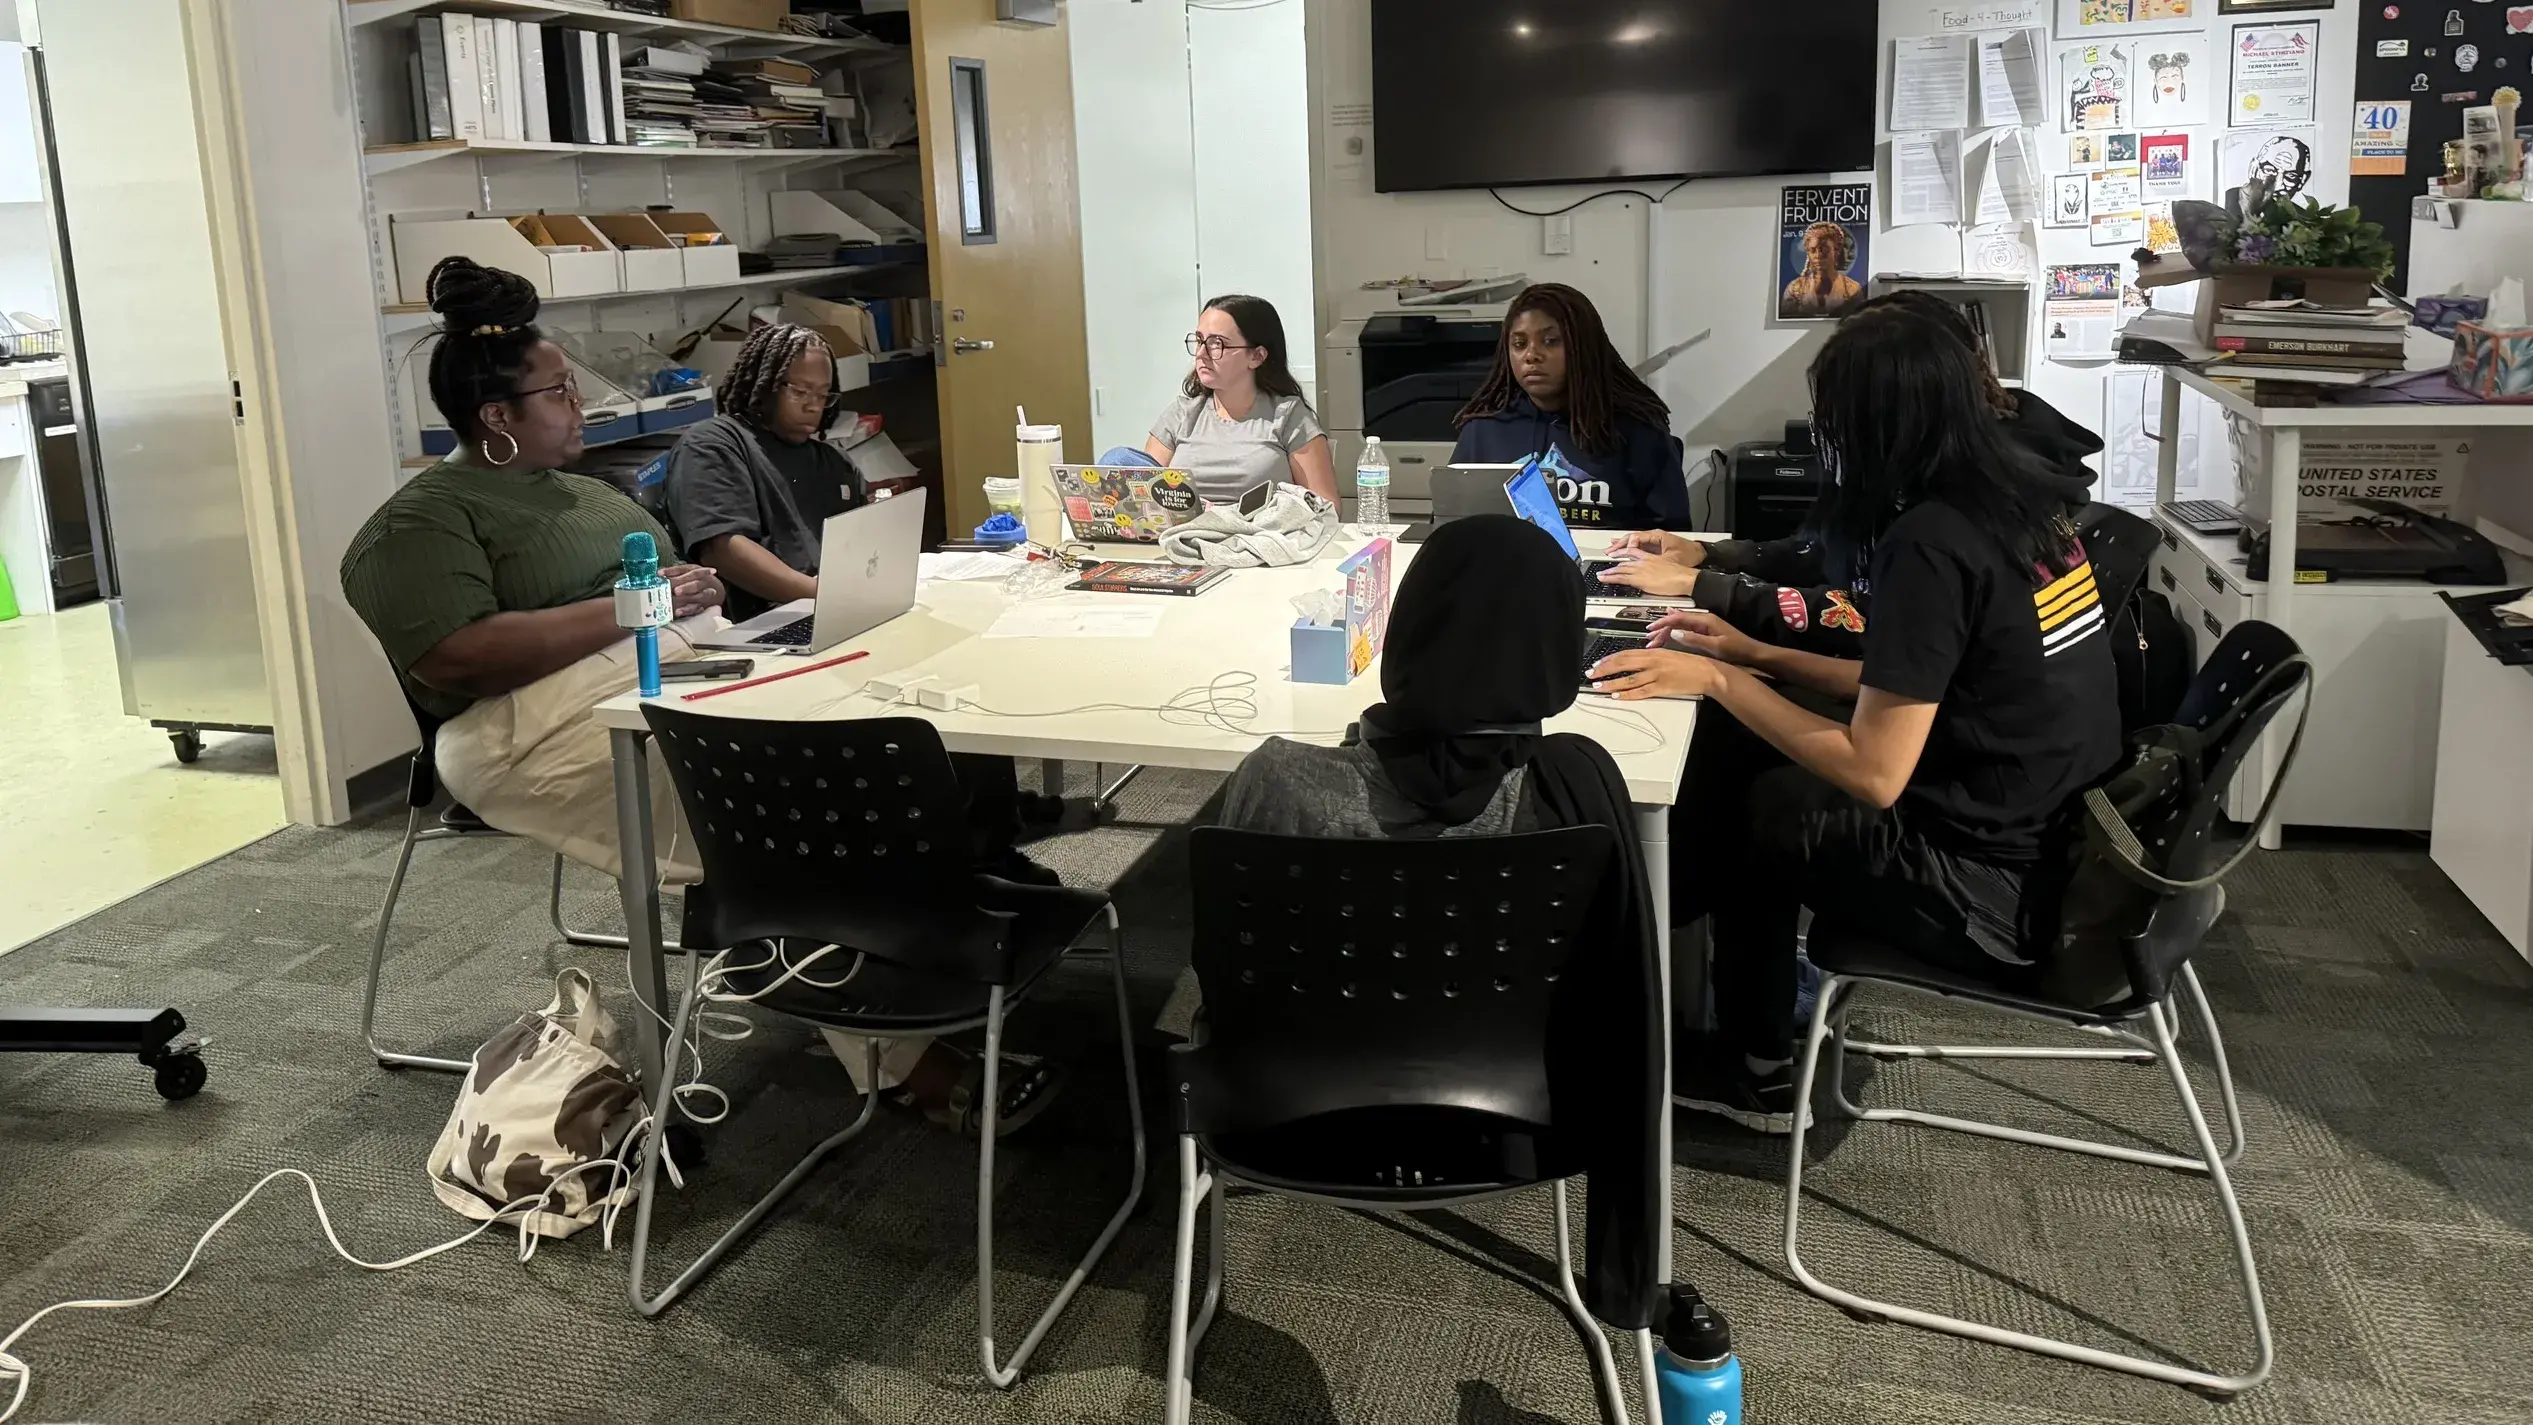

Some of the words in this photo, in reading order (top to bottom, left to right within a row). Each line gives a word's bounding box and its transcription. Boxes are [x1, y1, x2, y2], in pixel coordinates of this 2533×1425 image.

[1942, 12, 1968, 27] Food
[2363, 106, 2398, 130] 40
[1784, 187, 1869, 206] FERVENT
[1784, 204, 1868, 223] FRUITION
[2268, 341, 2305, 351] EMERSON
[2306, 342, 2350, 353] BURKHART
[637, 461, 662, 482] STAPLES
[2298, 468, 2363, 481] UNITED
[2368, 468, 2438, 481] STATES
[1154, 487, 1192, 498] Virginia
[1557, 477, 1613, 508] on
[2365, 485, 2444, 498] SERVICE
[1173, 496, 1187, 504] for
[1559, 507, 1601, 521] BEER
